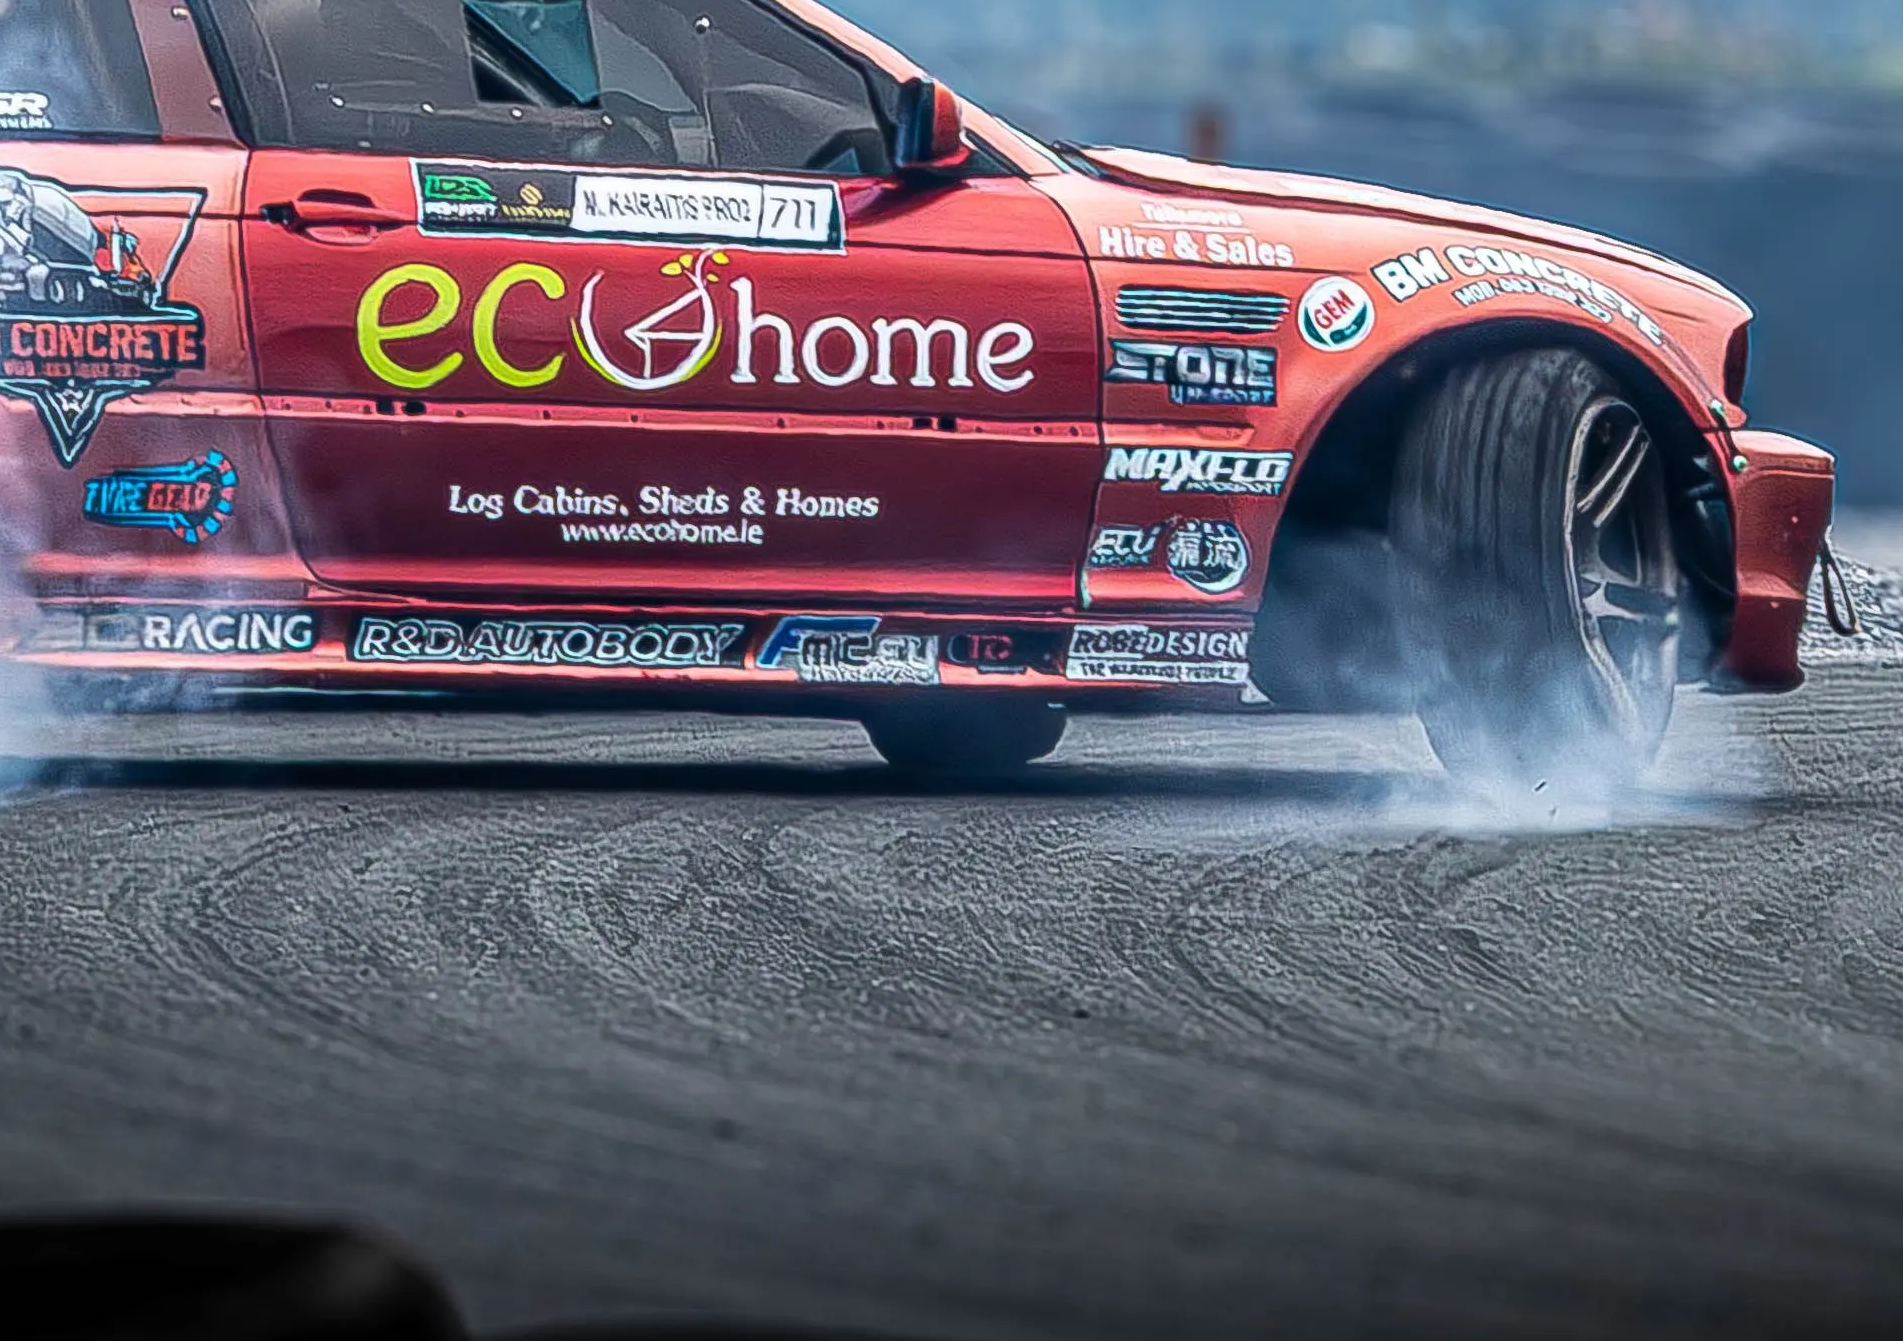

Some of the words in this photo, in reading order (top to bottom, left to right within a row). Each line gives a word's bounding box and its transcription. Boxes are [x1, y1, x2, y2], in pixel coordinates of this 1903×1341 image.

[769, 197, 818, 230] 711
[1098, 226, 1166, 258] Hire
[1172, 229, 1201, 261] &
[1205, 233, 1295, 267] Sales
[1313, 288, 1357, 330] GEM
[1371, 246, 1452, 303] BM
[1444, 244, 1664, 346] CONCRETE
[10, 322, 199, 362] CONCRETE
[449, 484, 504, 519] Log
[638, 485, 730, 516] Sheds
[740, 487, 766, 516] &
[774, 487, 880, 519] Homes
